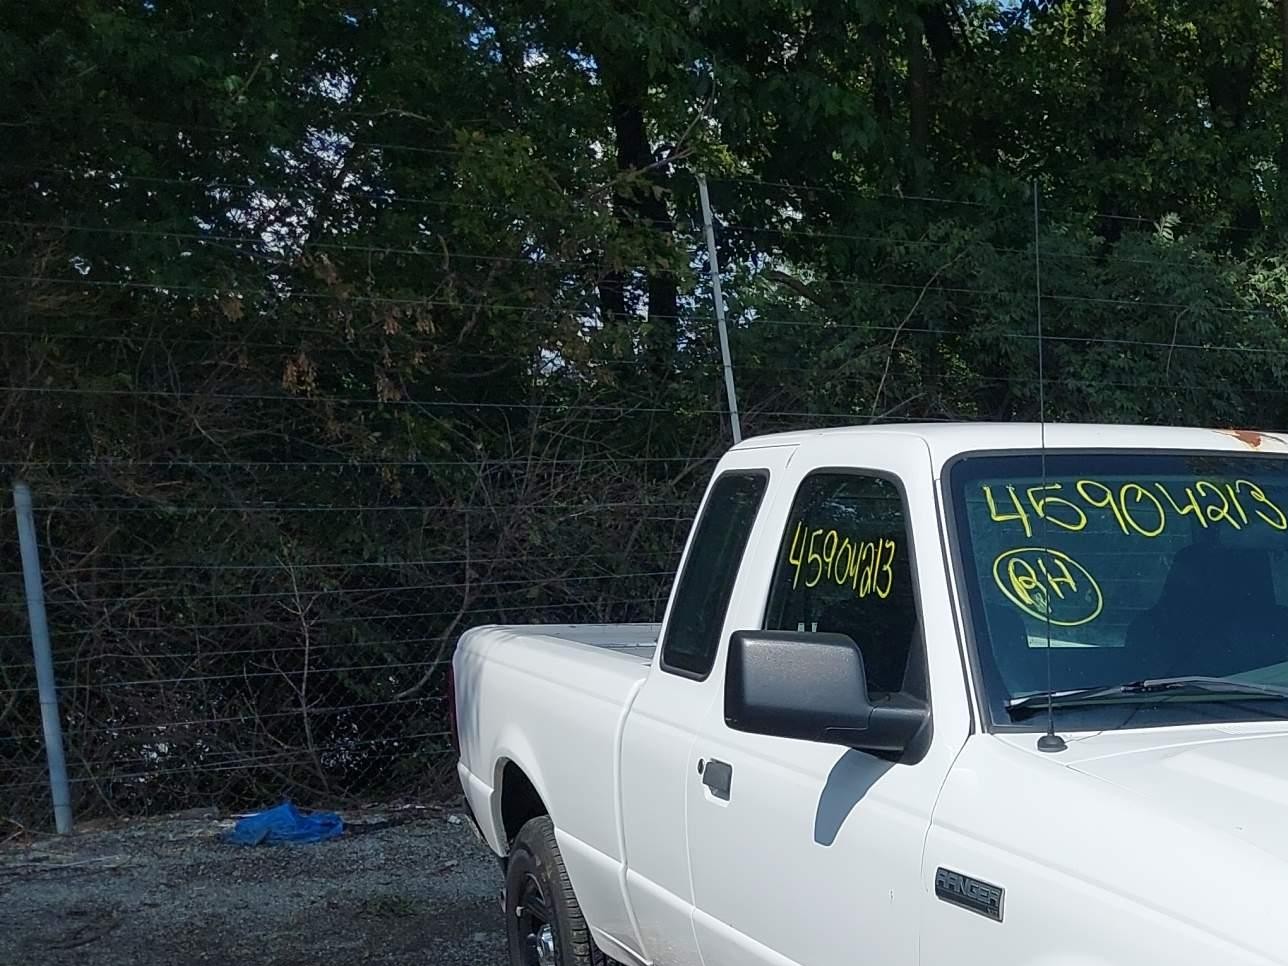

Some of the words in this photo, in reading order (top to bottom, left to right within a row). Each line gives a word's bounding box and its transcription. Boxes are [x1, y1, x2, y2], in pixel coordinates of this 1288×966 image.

[982, 479, 1288, 538] 45904213
[787, 521, 896, 598] 45904213
[936, 869, 1001, 907] RANGER
